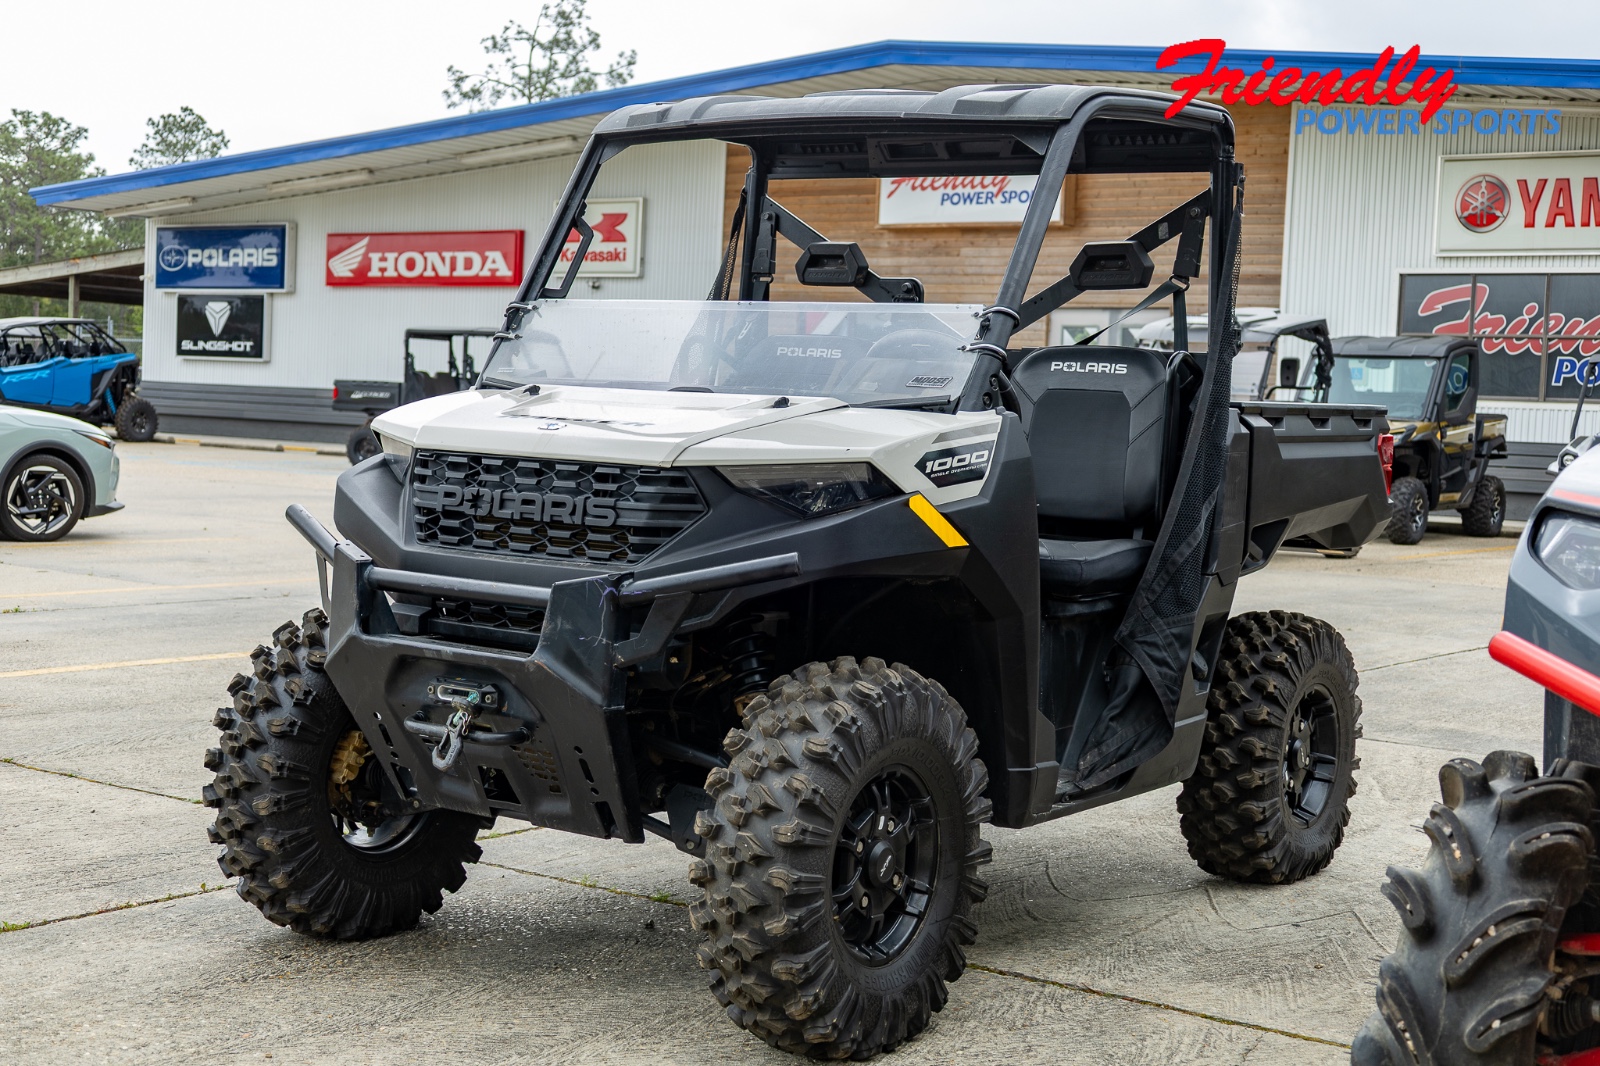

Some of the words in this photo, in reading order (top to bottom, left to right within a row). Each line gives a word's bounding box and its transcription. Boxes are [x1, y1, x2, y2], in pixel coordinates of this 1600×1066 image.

[940, 191, 995, 206] POWER
[1000, 190, 1034, 205] SPO
[187, 248, 279, 268] POLARIS
[367, 250, 513, 278] HONDA
[181, 339, 254, 352] SLINGSHOT
[777, 346, 842, 359] POLARIS
[1050, 361, 1128, 375] POLARIS
[911, 376, 951, 384] MOOSE
[925, 449, 990, 474] 1000
[436, 484, 618, 527] POLARIS
